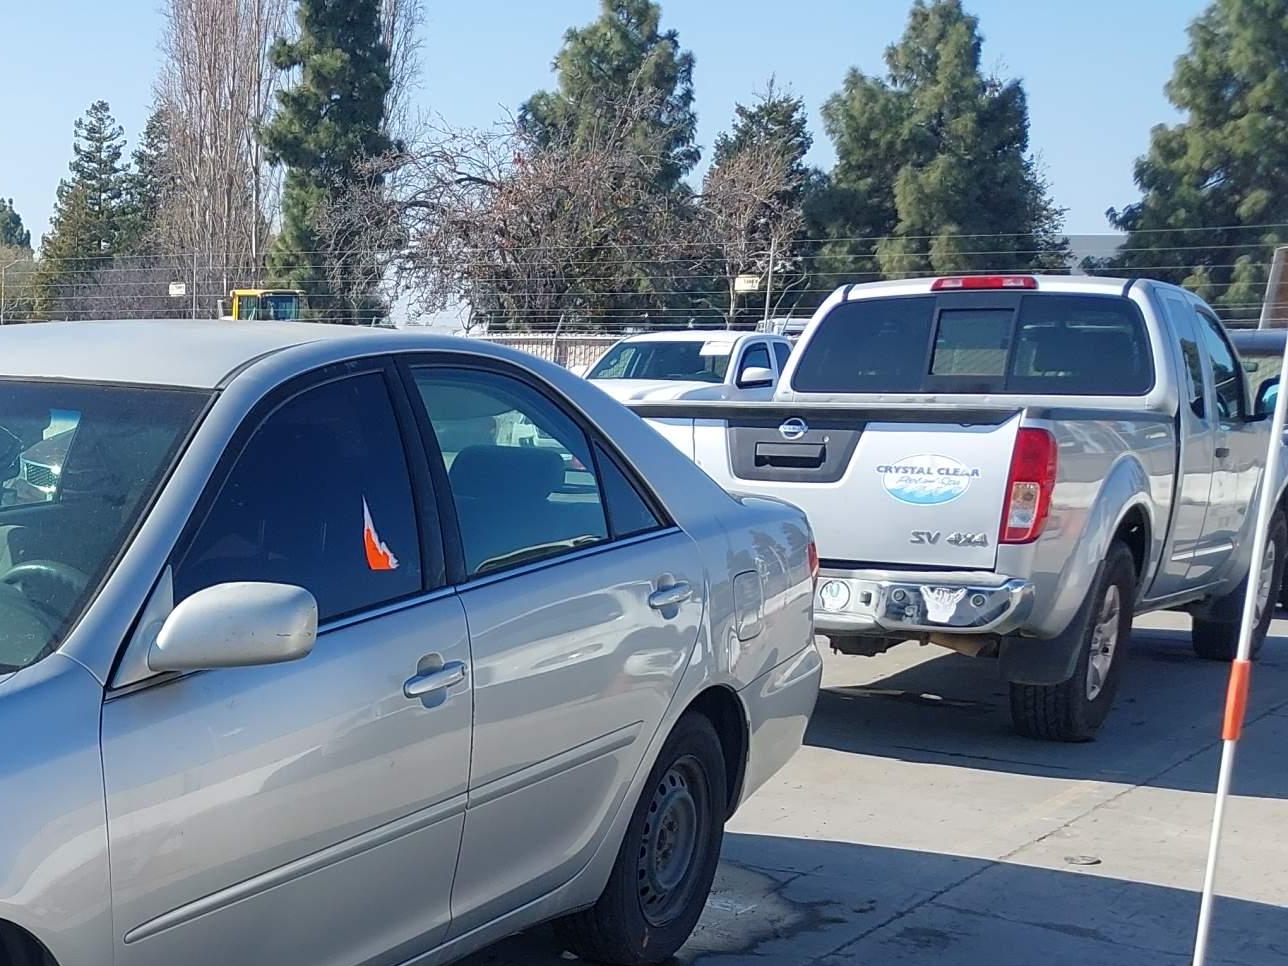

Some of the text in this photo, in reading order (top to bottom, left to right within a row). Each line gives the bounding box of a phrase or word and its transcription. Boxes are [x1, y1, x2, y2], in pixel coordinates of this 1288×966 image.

[876, 465, 980, 477] CRYSTAL CLEAR
[910, 531, 941, 544] SV
